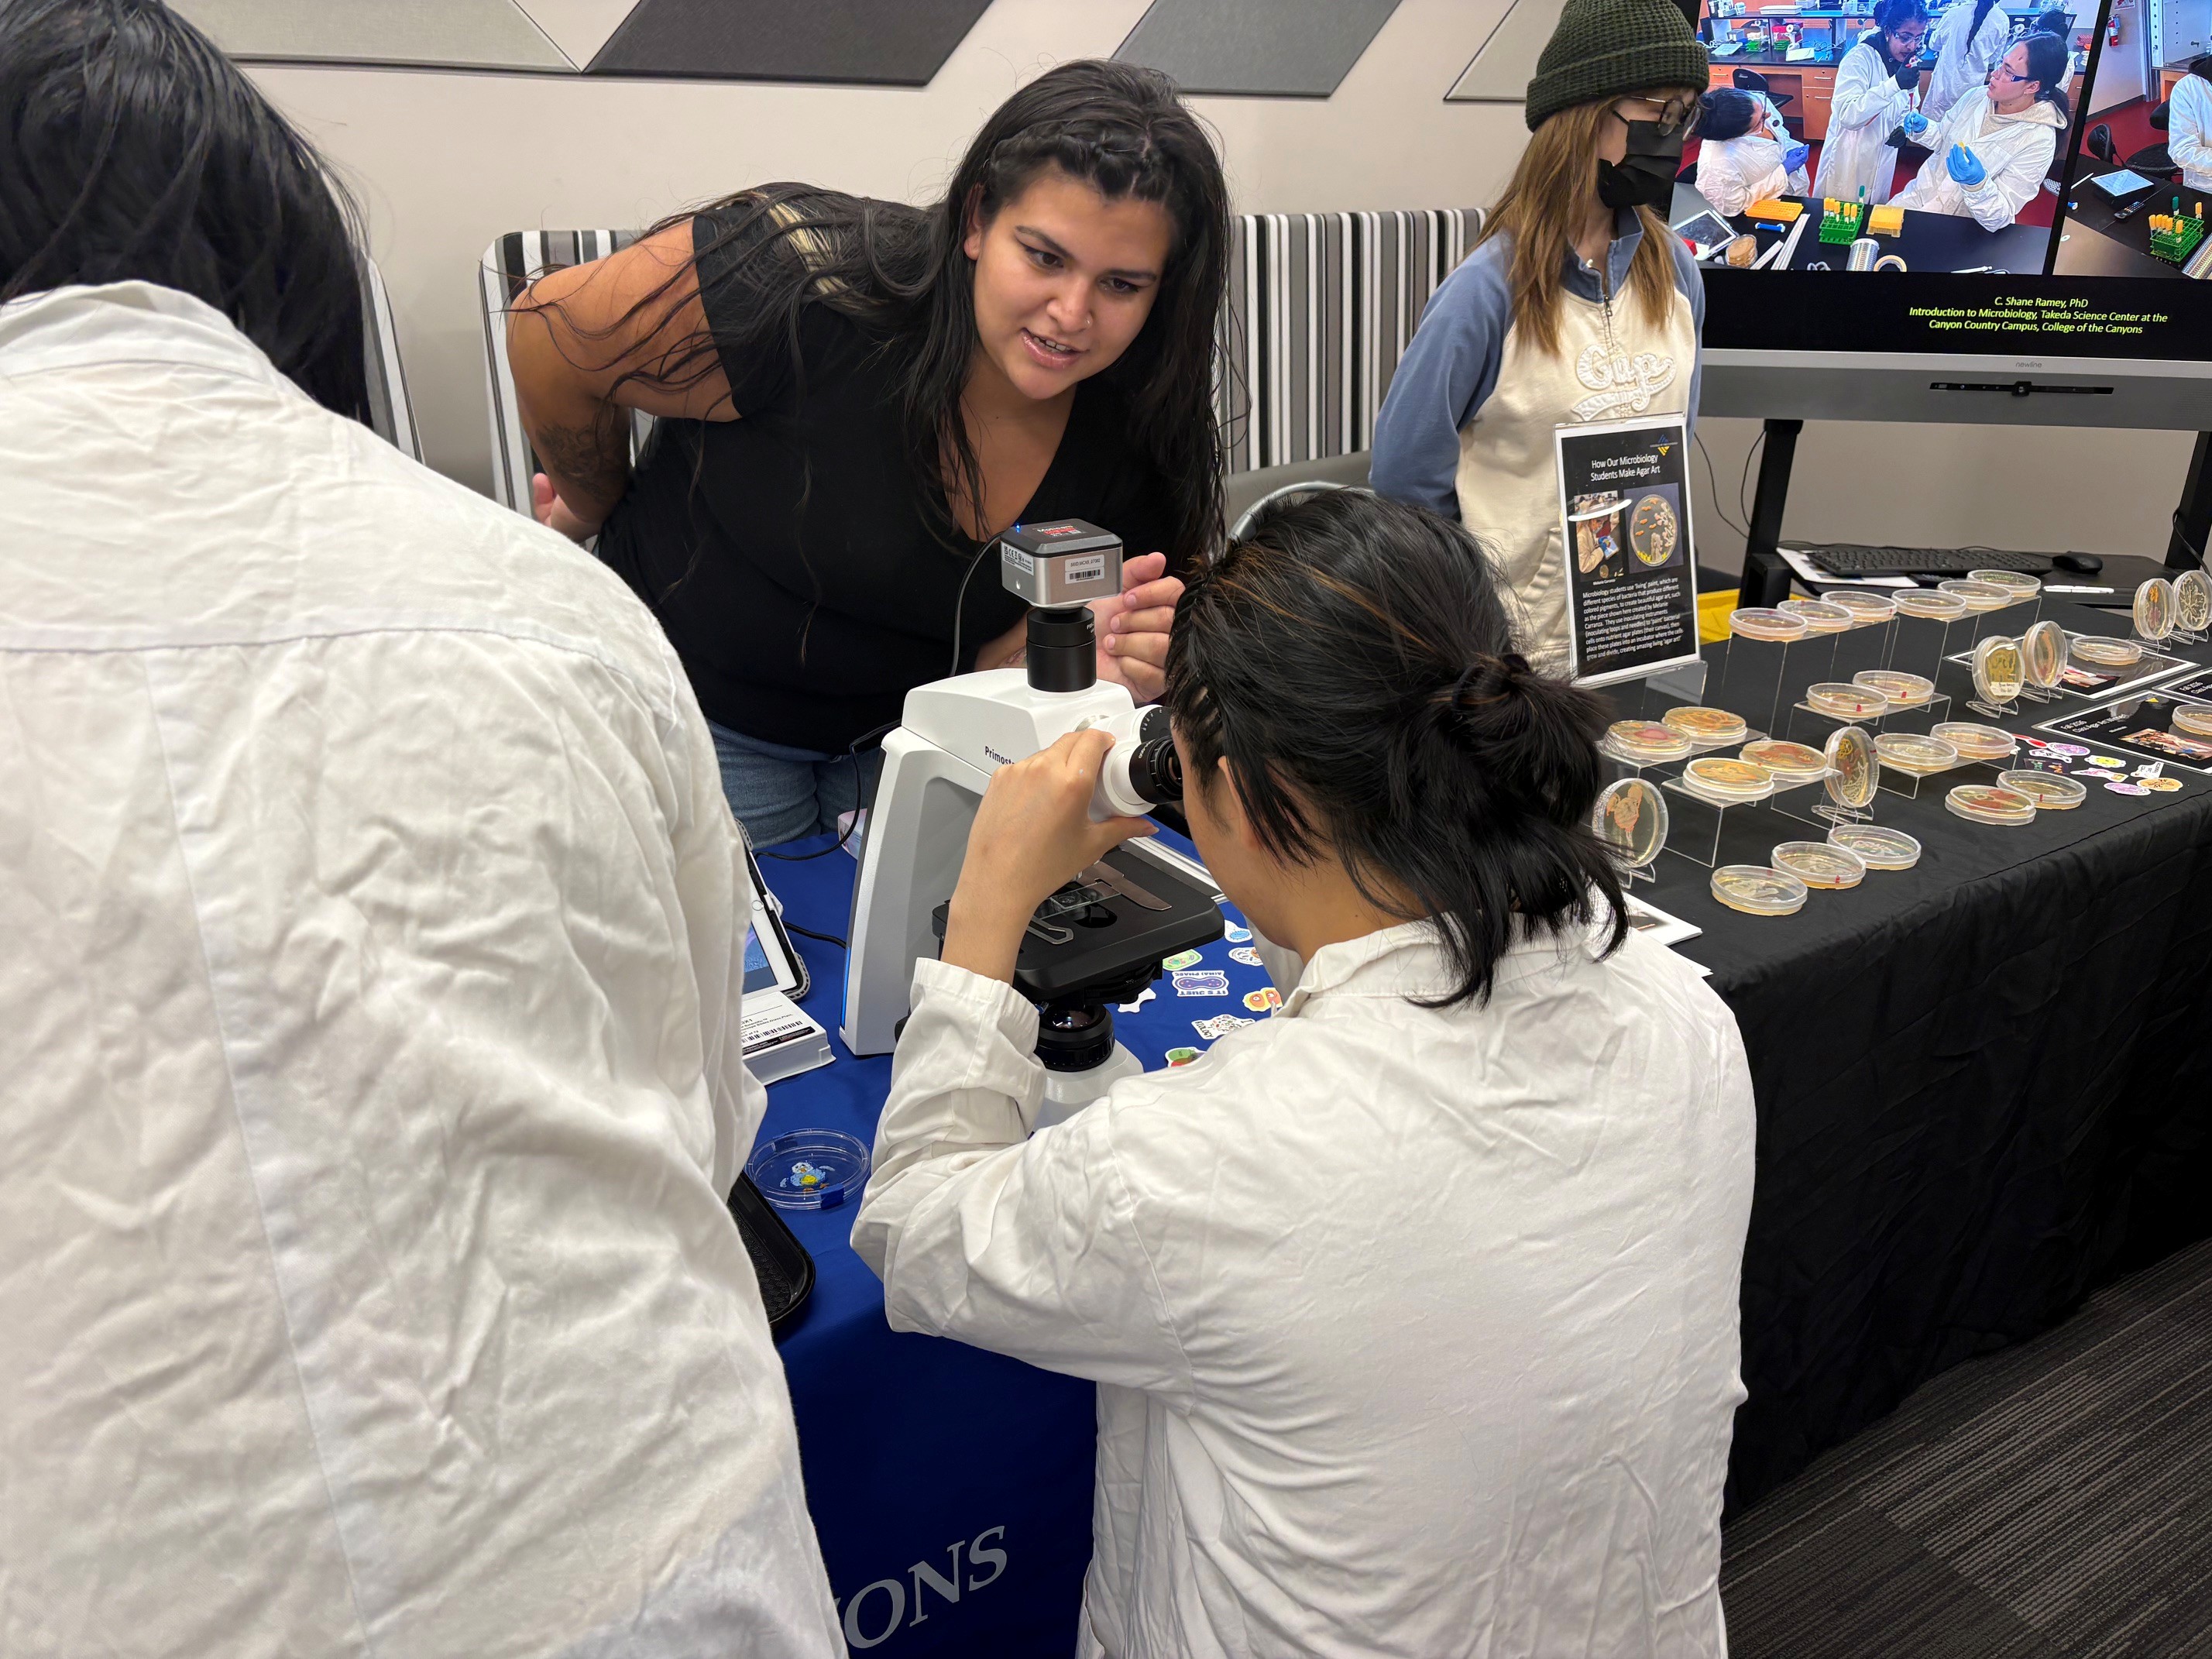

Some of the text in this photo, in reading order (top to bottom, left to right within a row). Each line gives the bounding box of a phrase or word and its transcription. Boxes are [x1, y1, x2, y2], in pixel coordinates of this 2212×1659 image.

[1994, 297, 2088, 308] C. Shane Ramey, PhD
[1909, 307, 1964, 317] Introduction
[1979, 308, 2038, 320] Microbiology,
[2041, 310, 2071, 319] Takeda
[2073, 311, 2107, 321] Science
[2109, 312, 2139, 321] Center
[2152, 313, 2168, 322] the
[1929, 320, 2143, 335] Canyon Country Campus, College of the Canyons
[1592, 454, 1658, 469] How Our Microbiology
[1591, 472, 1618, 482] Students
[1637, 467, 1650, 477] Agar
[1645, 609, 1668, 617] instruments
[984, 745, 1015, 765] Primost
[826, 1526, 1007, 1648] ONS
